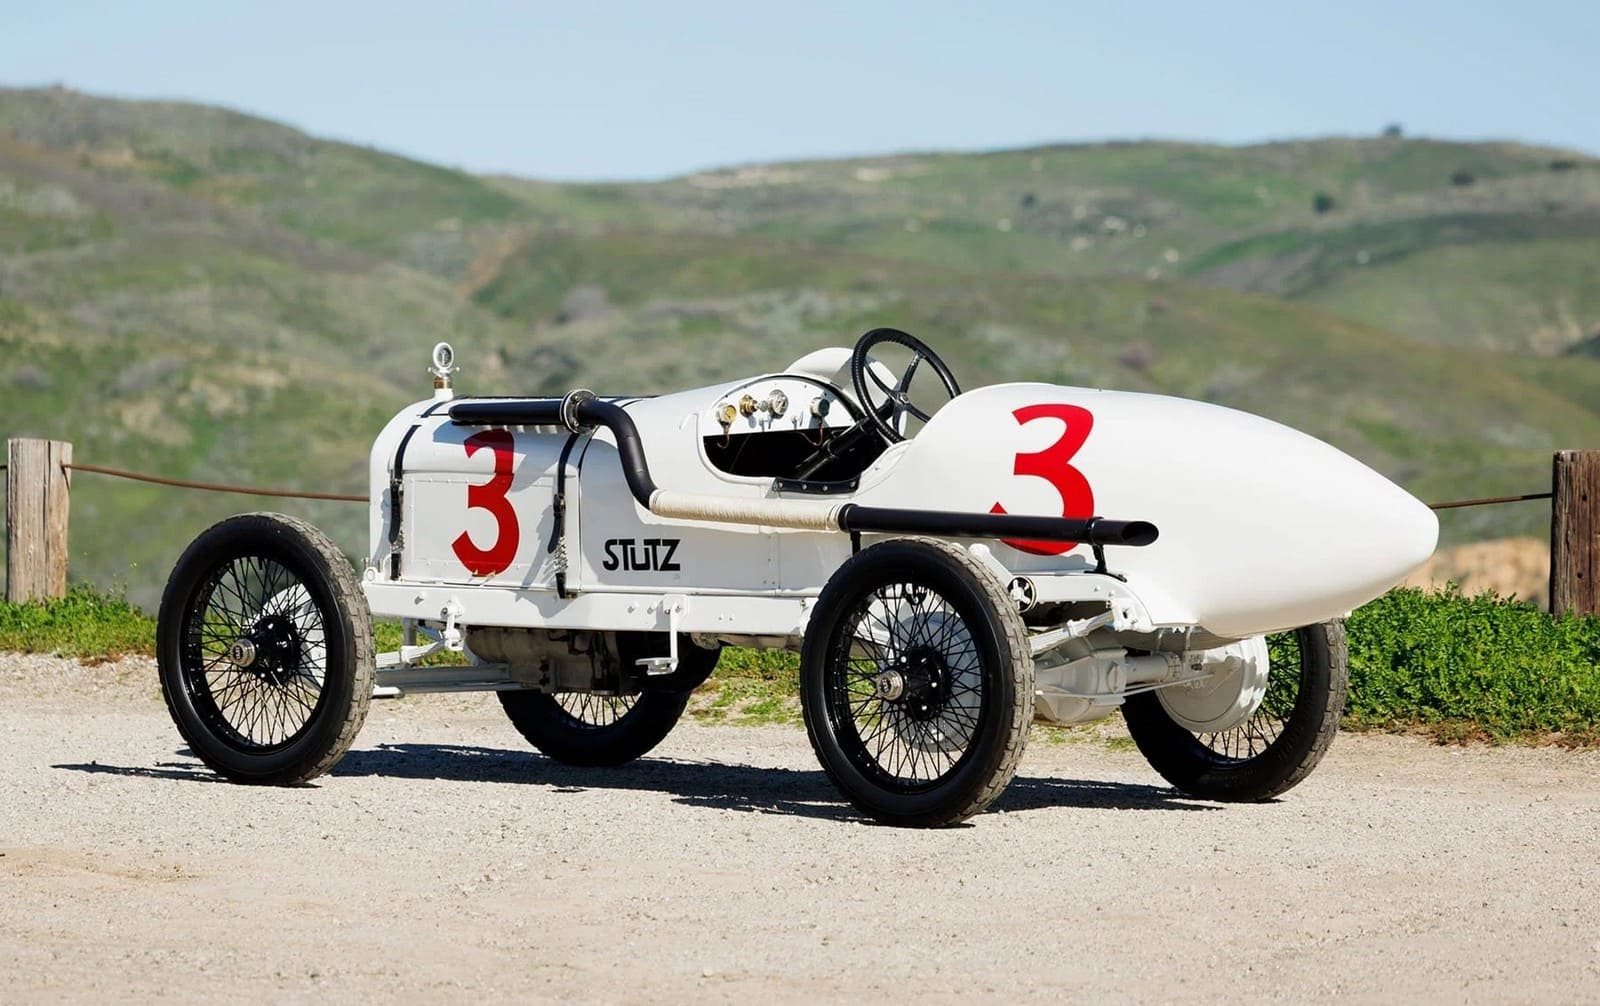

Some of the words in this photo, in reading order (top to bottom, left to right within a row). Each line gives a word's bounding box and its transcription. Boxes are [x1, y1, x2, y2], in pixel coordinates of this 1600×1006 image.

[452, 429, 520, 576] 3
[991, 404, 1095, 555] 3
[603, 539, 680, 571] STUTZ
